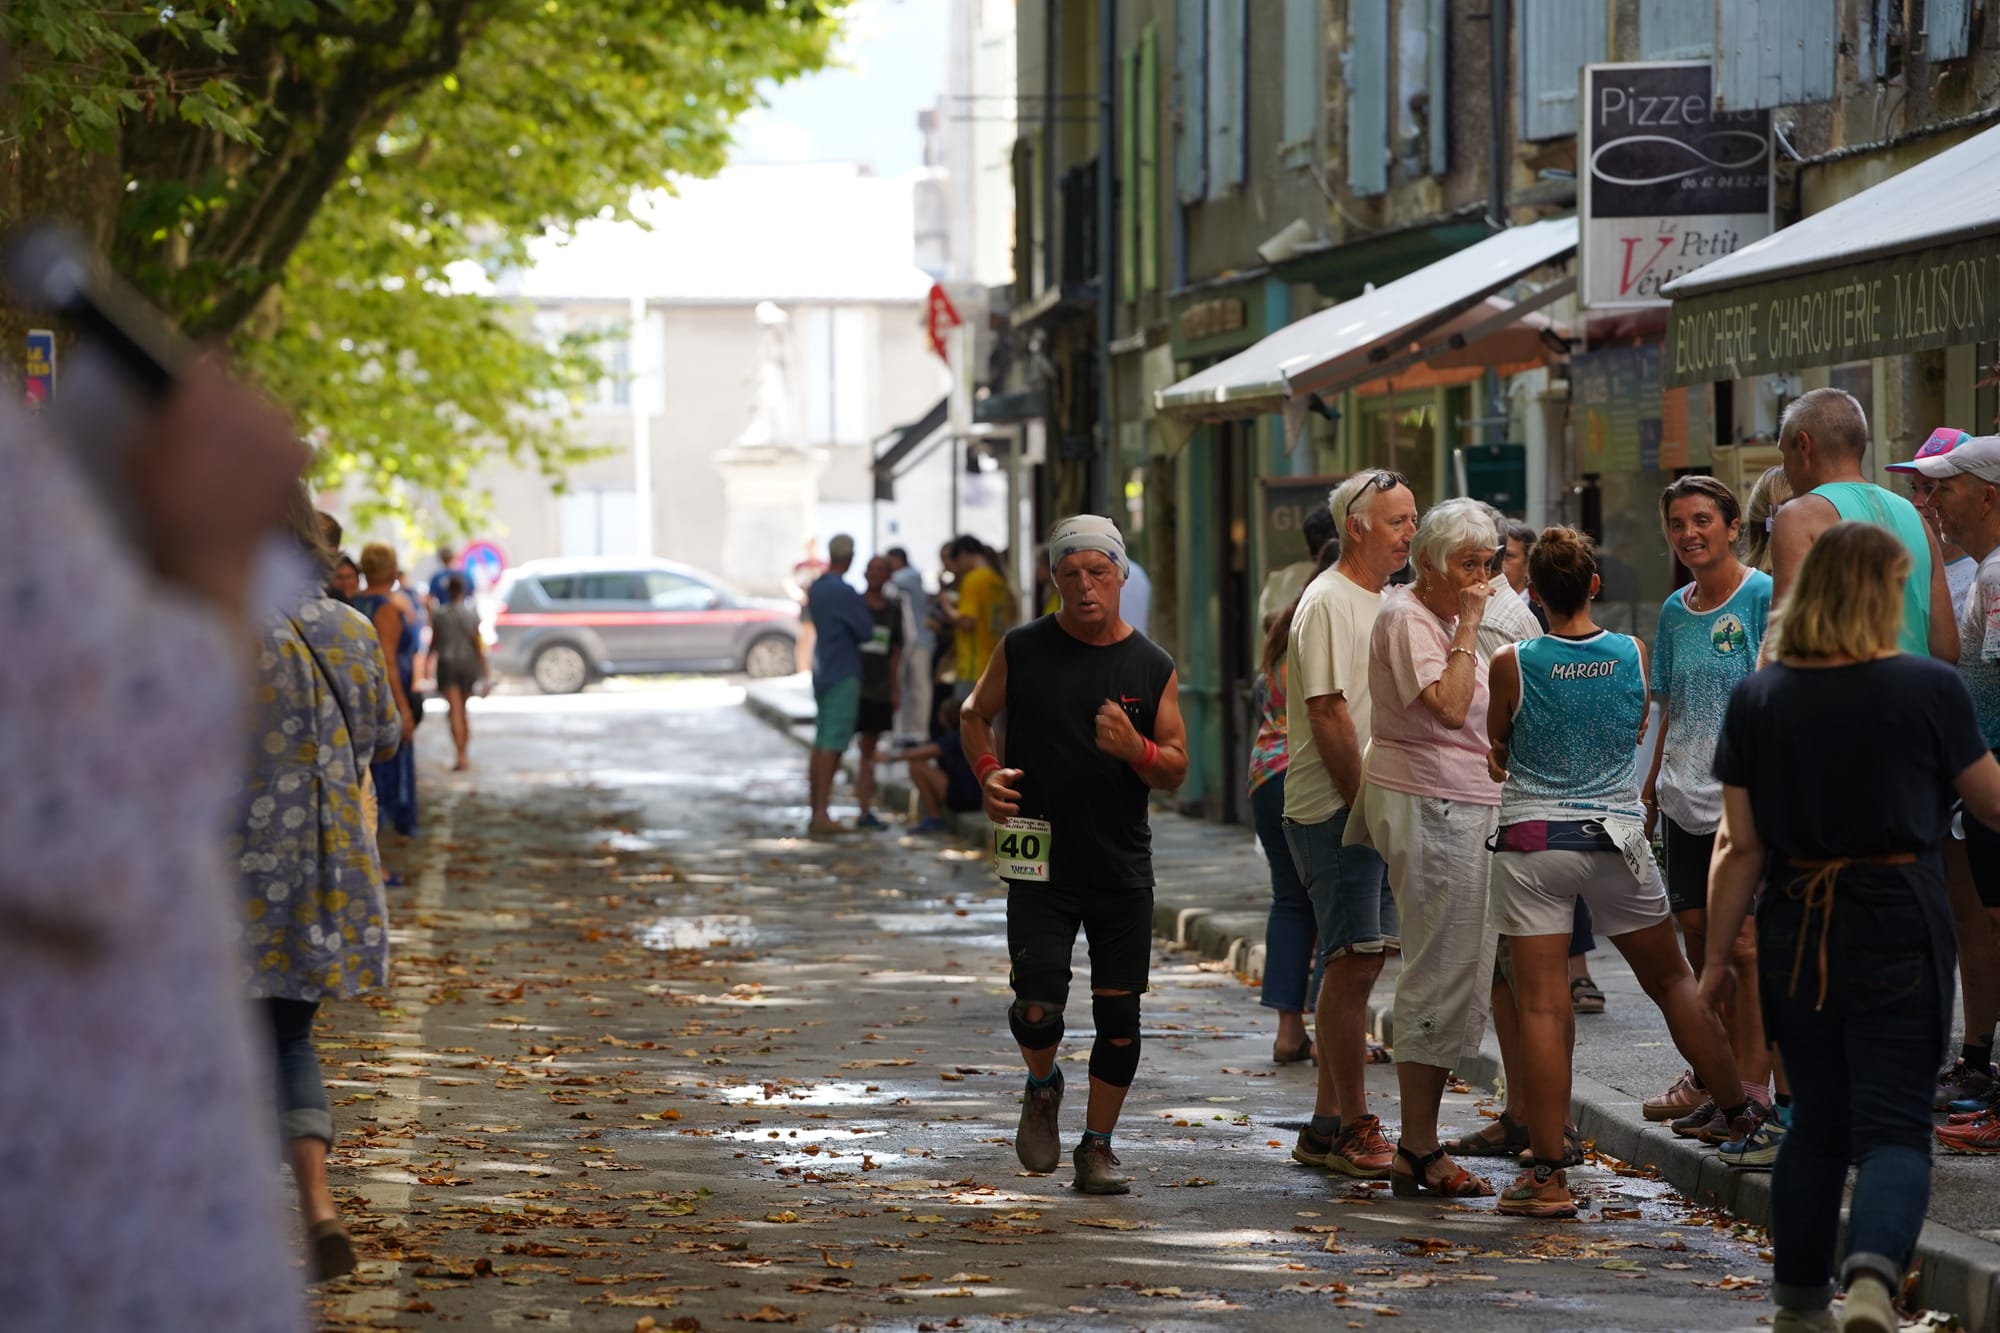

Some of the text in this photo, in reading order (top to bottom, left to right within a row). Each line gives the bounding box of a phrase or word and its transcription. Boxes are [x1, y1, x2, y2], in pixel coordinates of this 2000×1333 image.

[1658, 219, 1677, 233] Le
[1678, 229, 1739, 257] Petit
[1675, 302, 1758, 375] BOUCHERIE
[1767, 279, 1882, 360] CHARCUTERIE
[1892, 257, 1986, 340] MAISON
[1550, 659, 1620, 681] MARGOT
